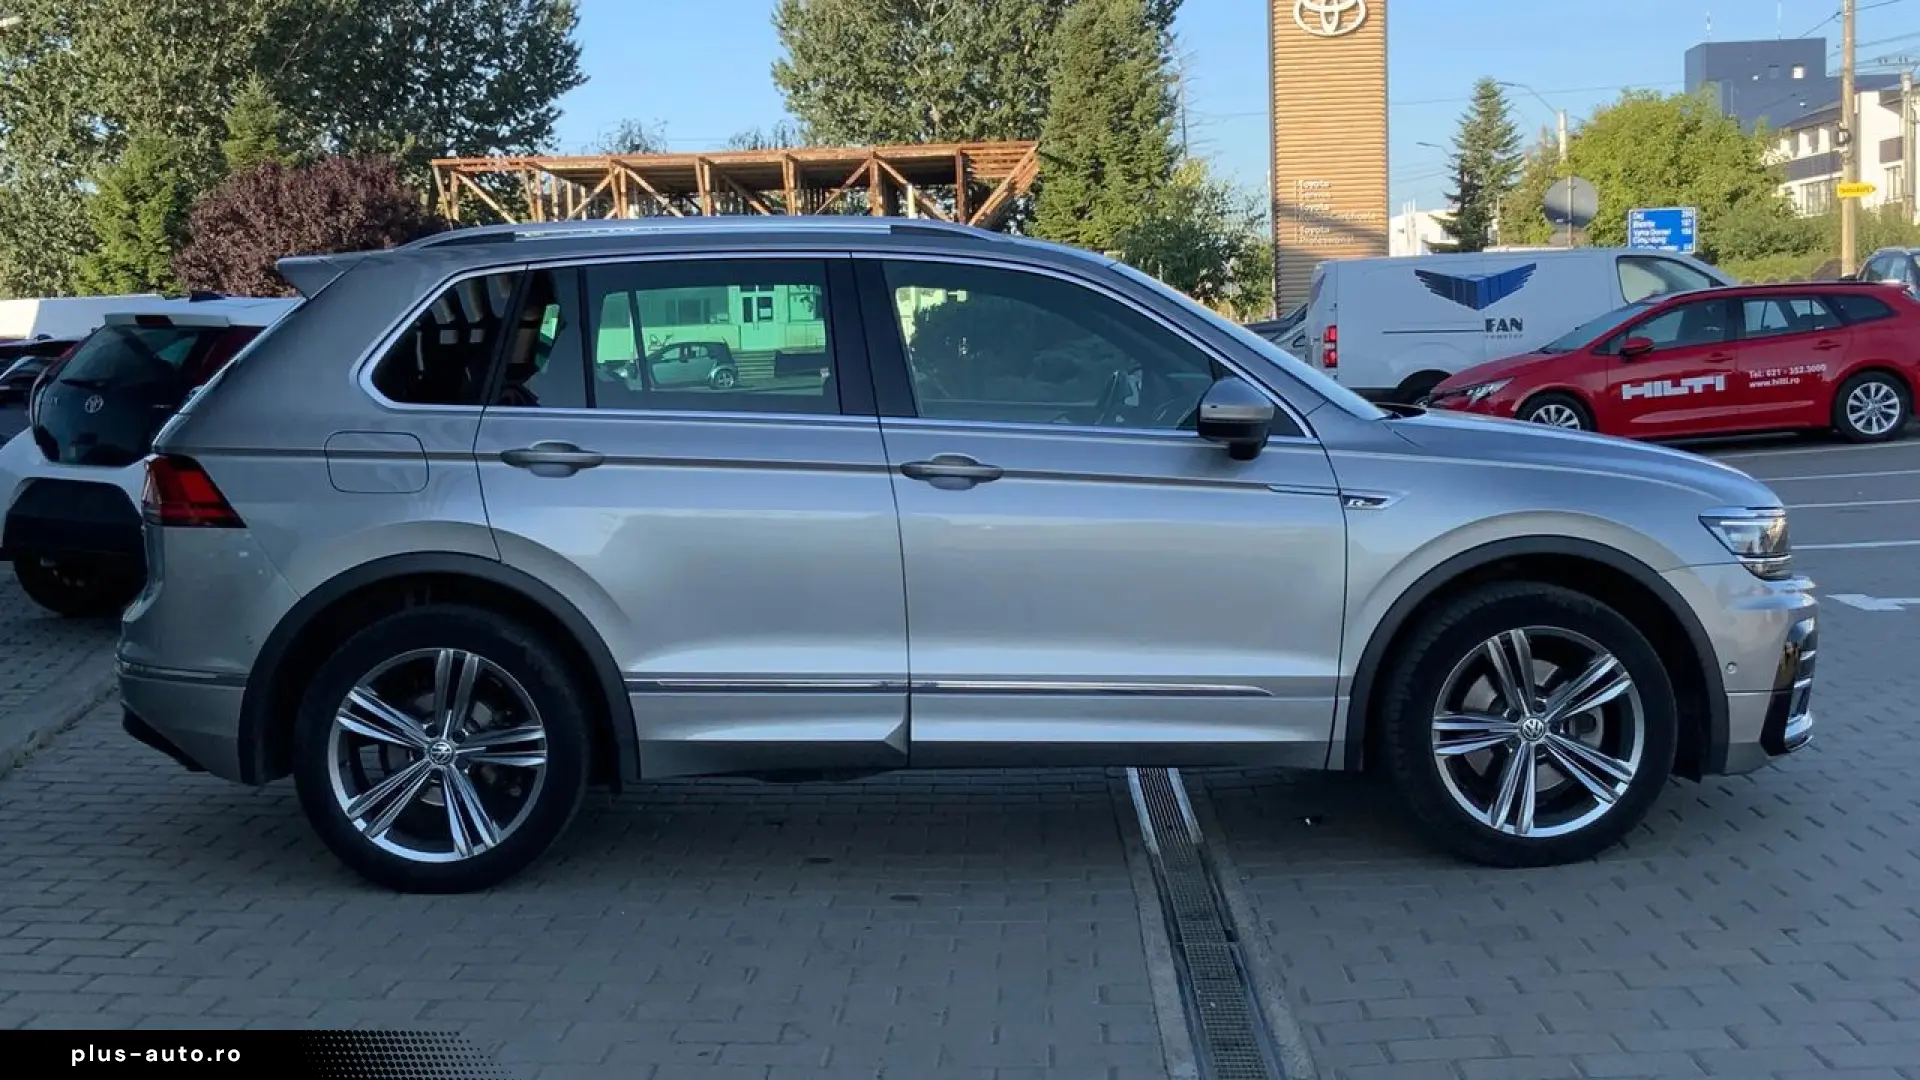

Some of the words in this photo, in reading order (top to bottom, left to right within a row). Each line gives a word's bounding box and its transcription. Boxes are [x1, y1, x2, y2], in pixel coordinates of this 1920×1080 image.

[1298, 203, 1330, 213] Toyota
[1298, 225, 1330, 235] Toyota
[1485, 317, 1523, 332] FAN
[1622, 374, 1726, 400] HILTI
[1749, 376, 1801, 388] www.hilti.ro
